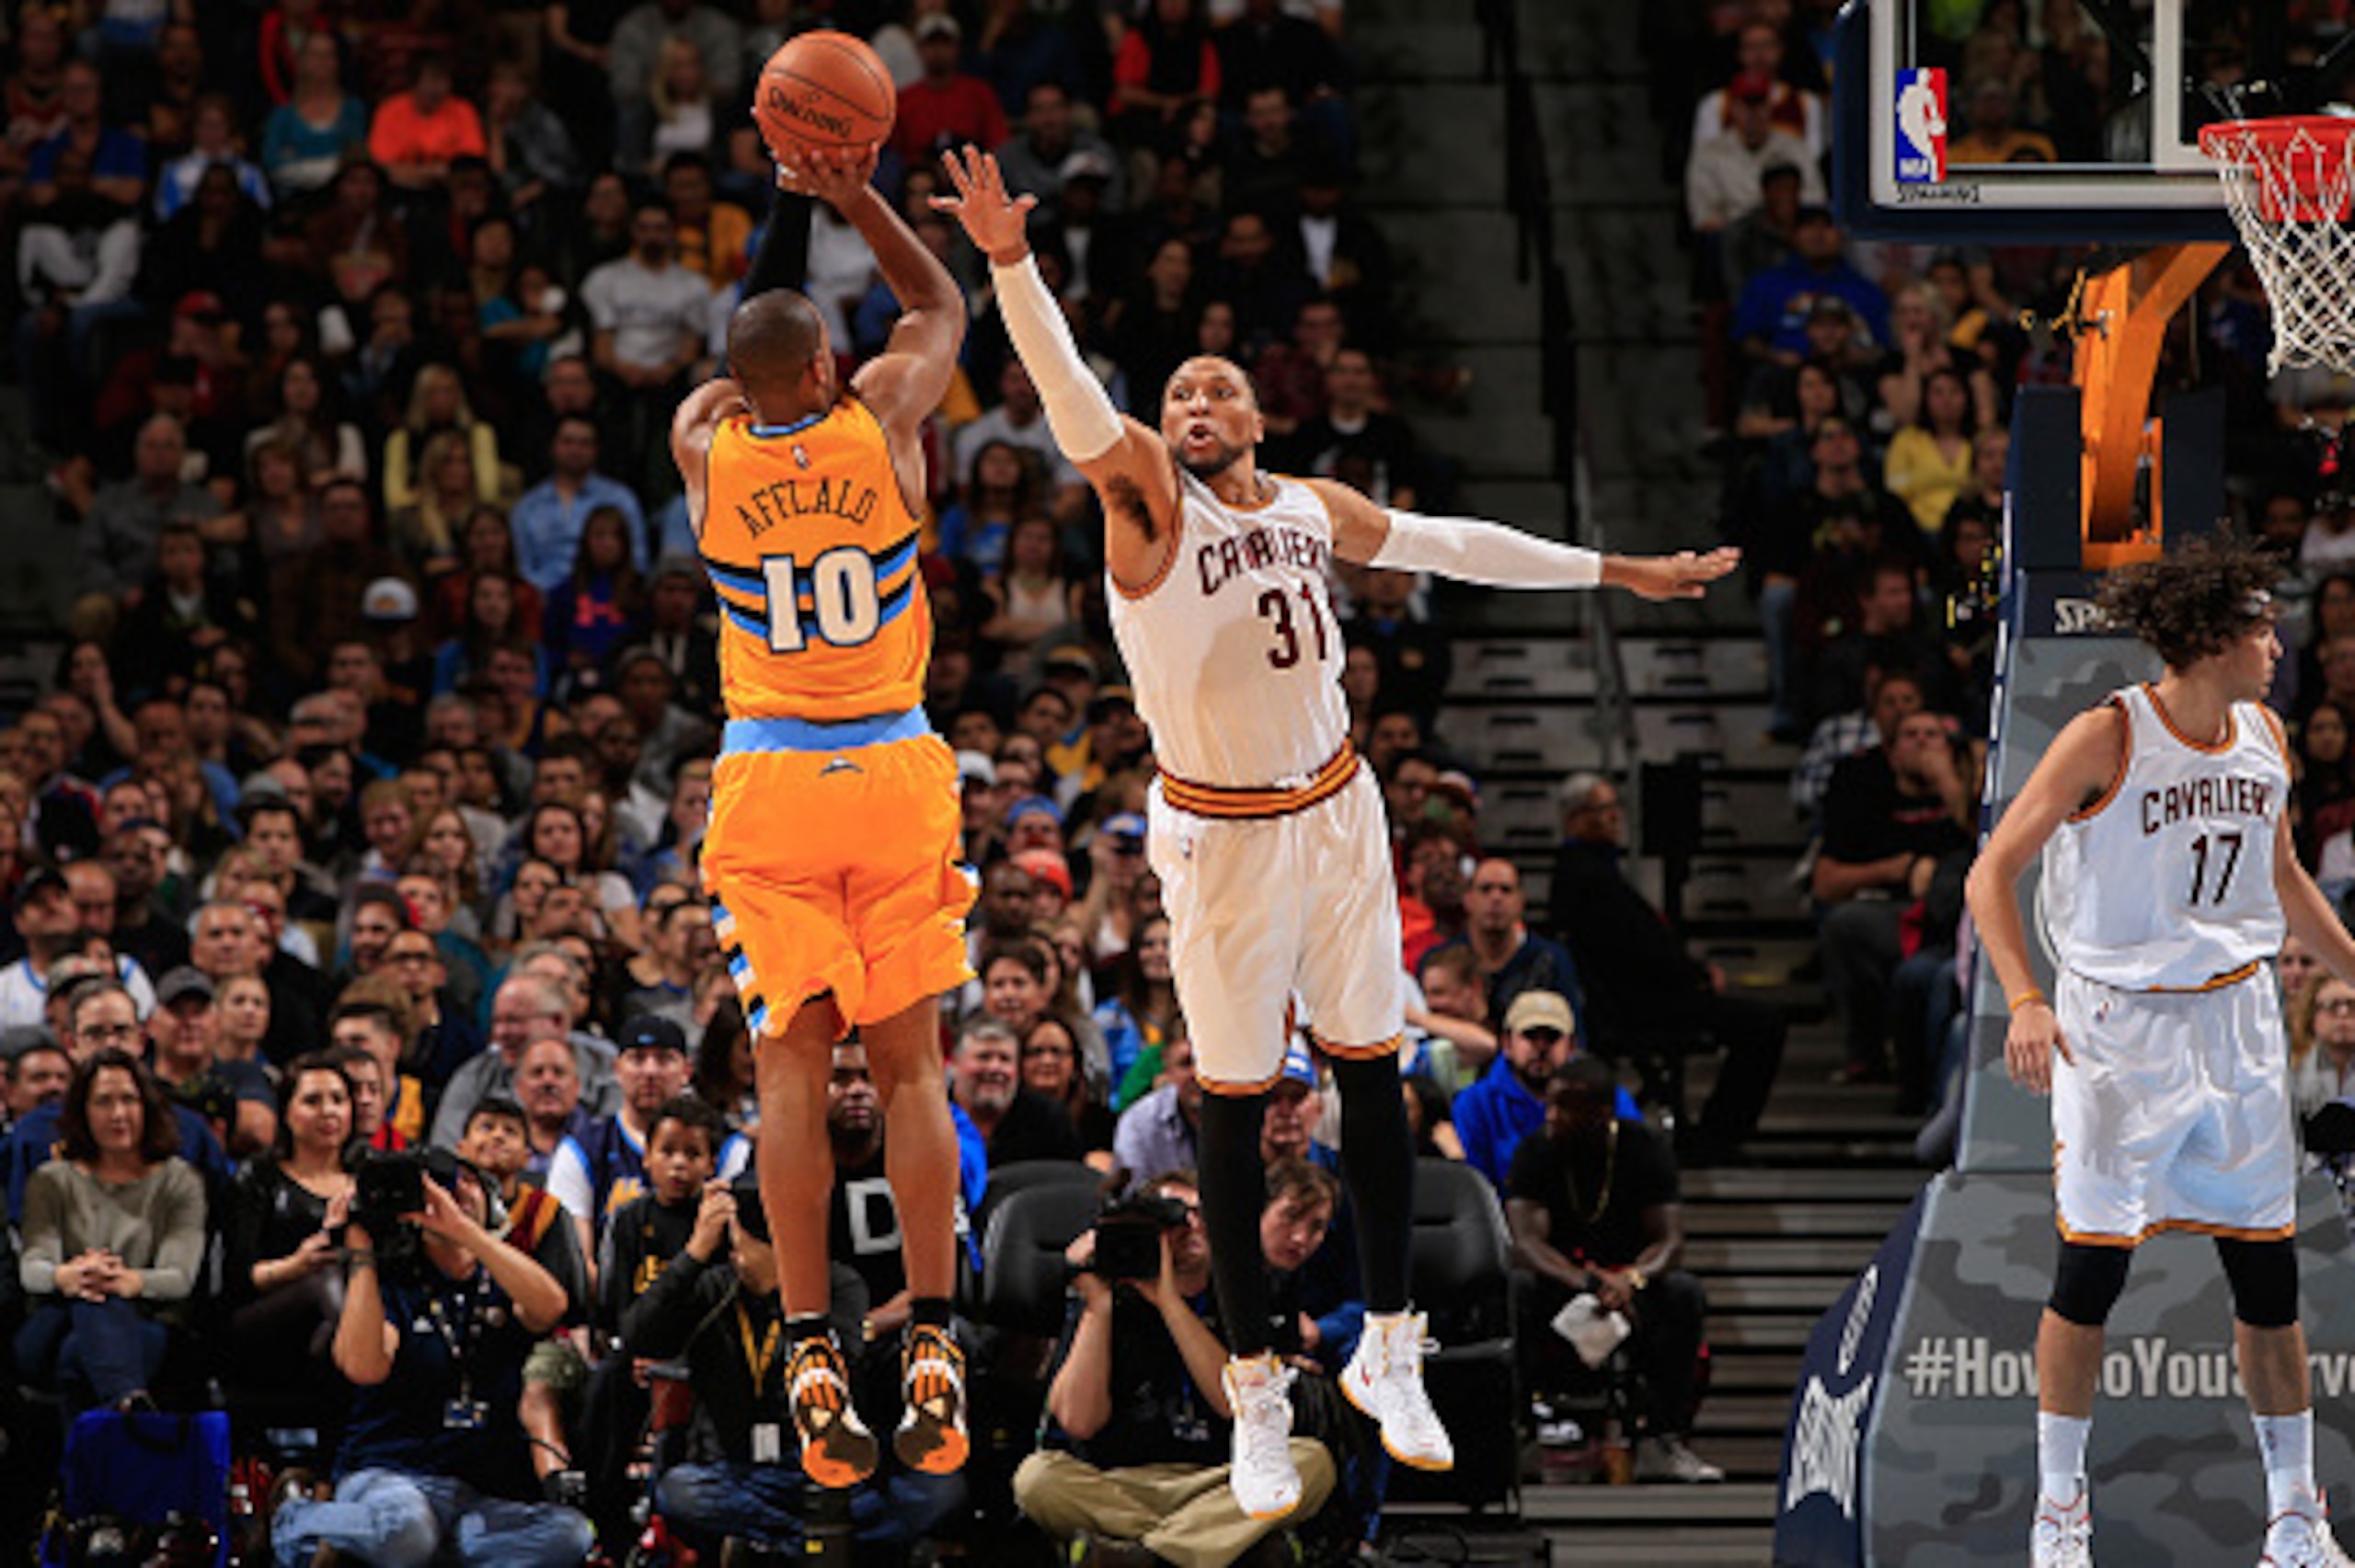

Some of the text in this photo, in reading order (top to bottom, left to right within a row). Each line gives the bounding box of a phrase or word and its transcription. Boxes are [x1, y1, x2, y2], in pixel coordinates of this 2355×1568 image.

[769, 86, 855, 139] SPALDING
[734, 475, 877, 540] AFFLALO
[759, 544, 880, 655] 10
[1258, 581, 1327, 670] 31
[2187, 833, 2243, 906] 17
